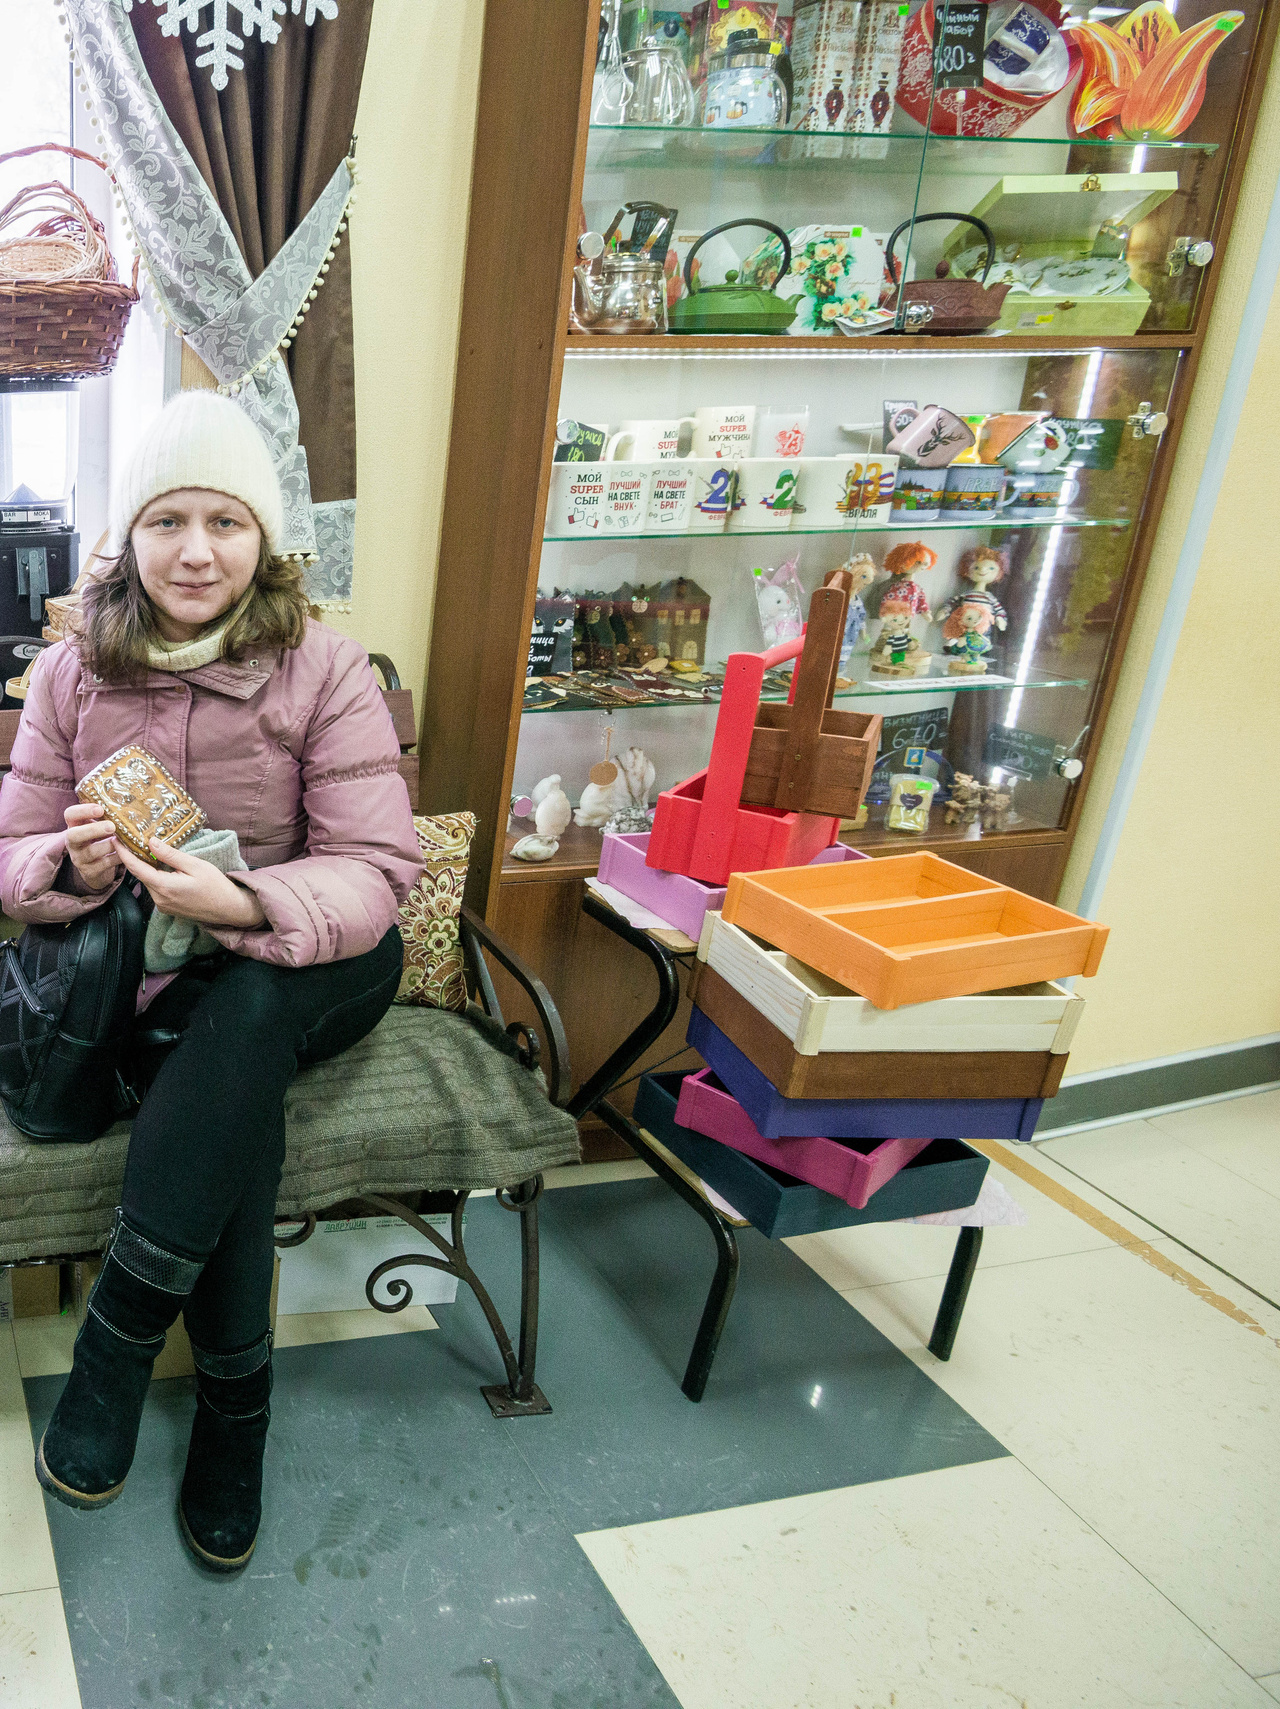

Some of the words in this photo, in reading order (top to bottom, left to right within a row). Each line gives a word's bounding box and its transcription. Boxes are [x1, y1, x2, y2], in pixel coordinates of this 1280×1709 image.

[719, 424, 748, 433] SUPER
[577, 471, 603, 483] МОЙ
[570, 484, 604, 494] SUPER
[609, 478, 641, 491] ЛУЧШИЙ
[655, 478, 687, 490] ЛУЧШИЙ
[607, 492, 618, 501] НА
[619, 490, 641, 501] СВЕТЕ
[653, 490, 664, 499] НА
[665, 489, 686, 499] СВЕТЕ
[574, 496, 599, 505] СЫН
